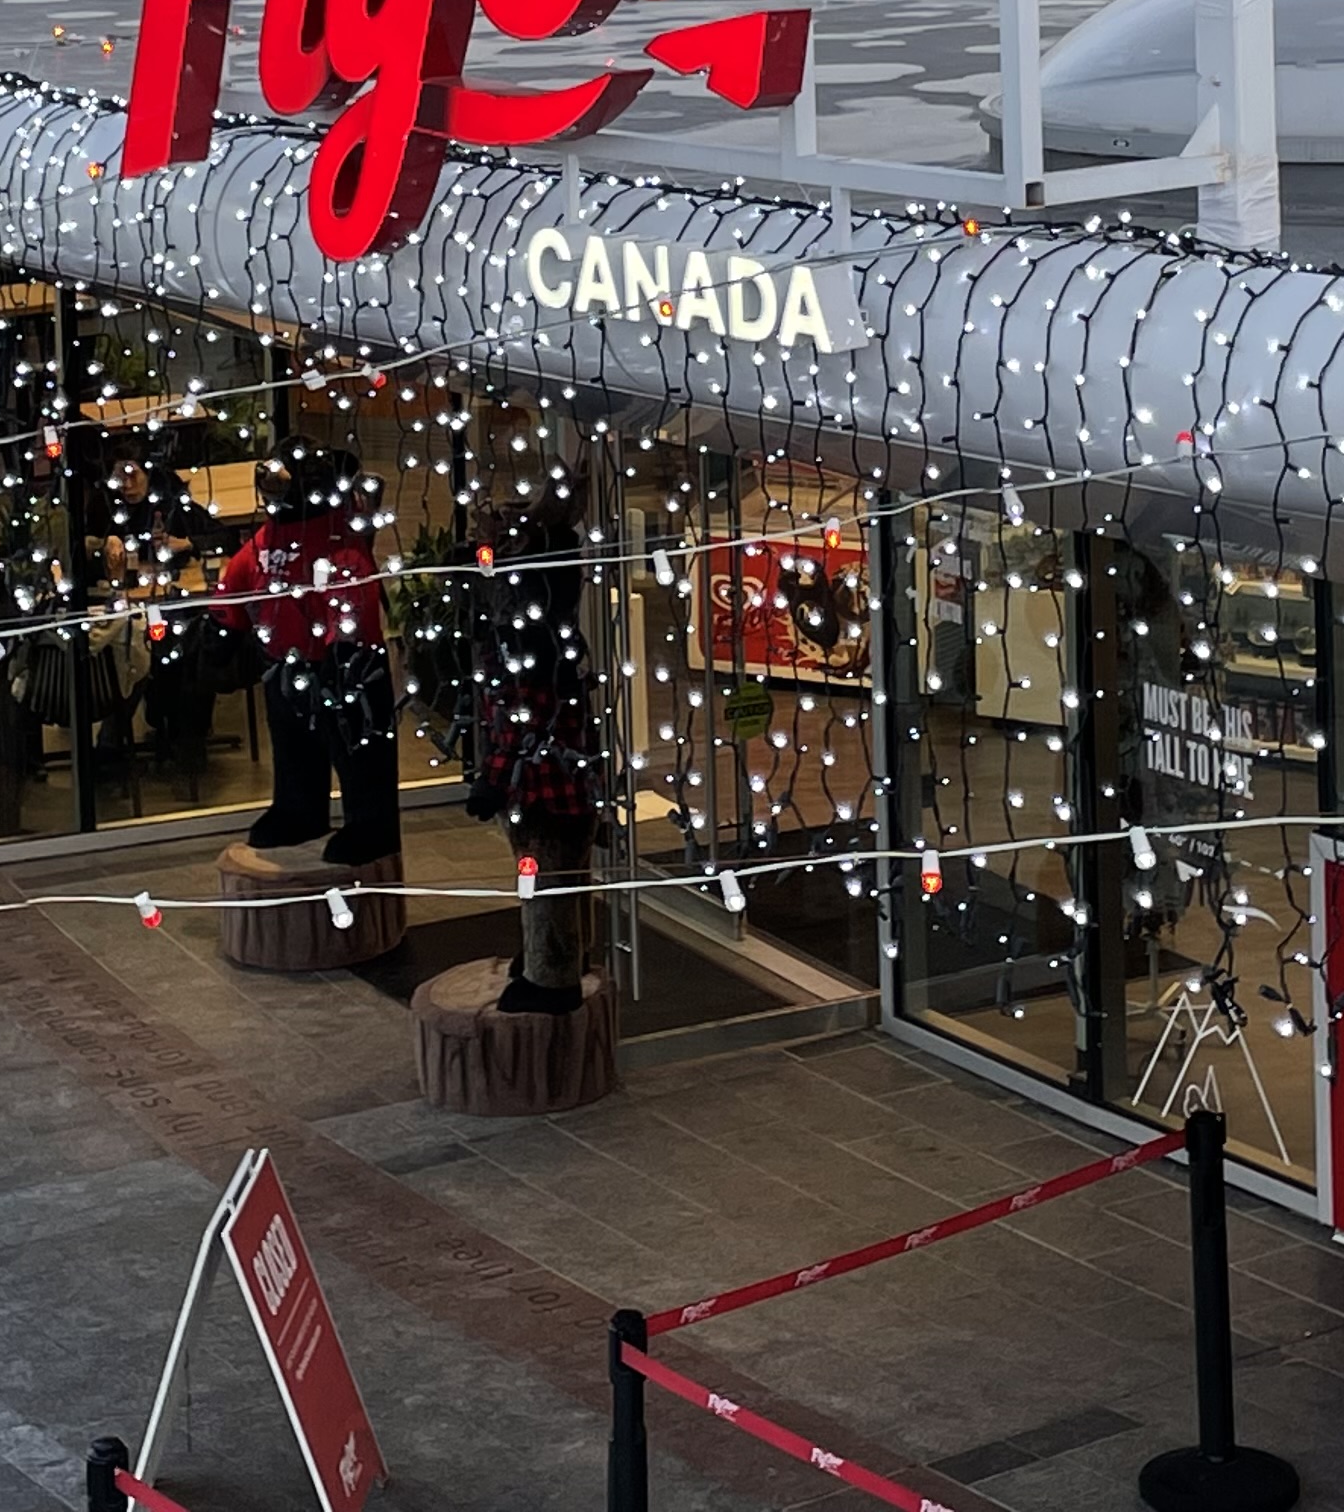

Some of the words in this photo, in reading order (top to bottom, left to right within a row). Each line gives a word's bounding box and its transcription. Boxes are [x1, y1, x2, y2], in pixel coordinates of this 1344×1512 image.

[527, 227, 833, 354] CANADA
[1143, 682, 1188, 731] MUST
[1192, 696, 1212, 737] BE
[1144, 728, 1185, 778] TALL
[1186, 740, 1209, 785] TO
[101, 1067, 174, 1110] sons
[177, 1078, 258, 1122] land
